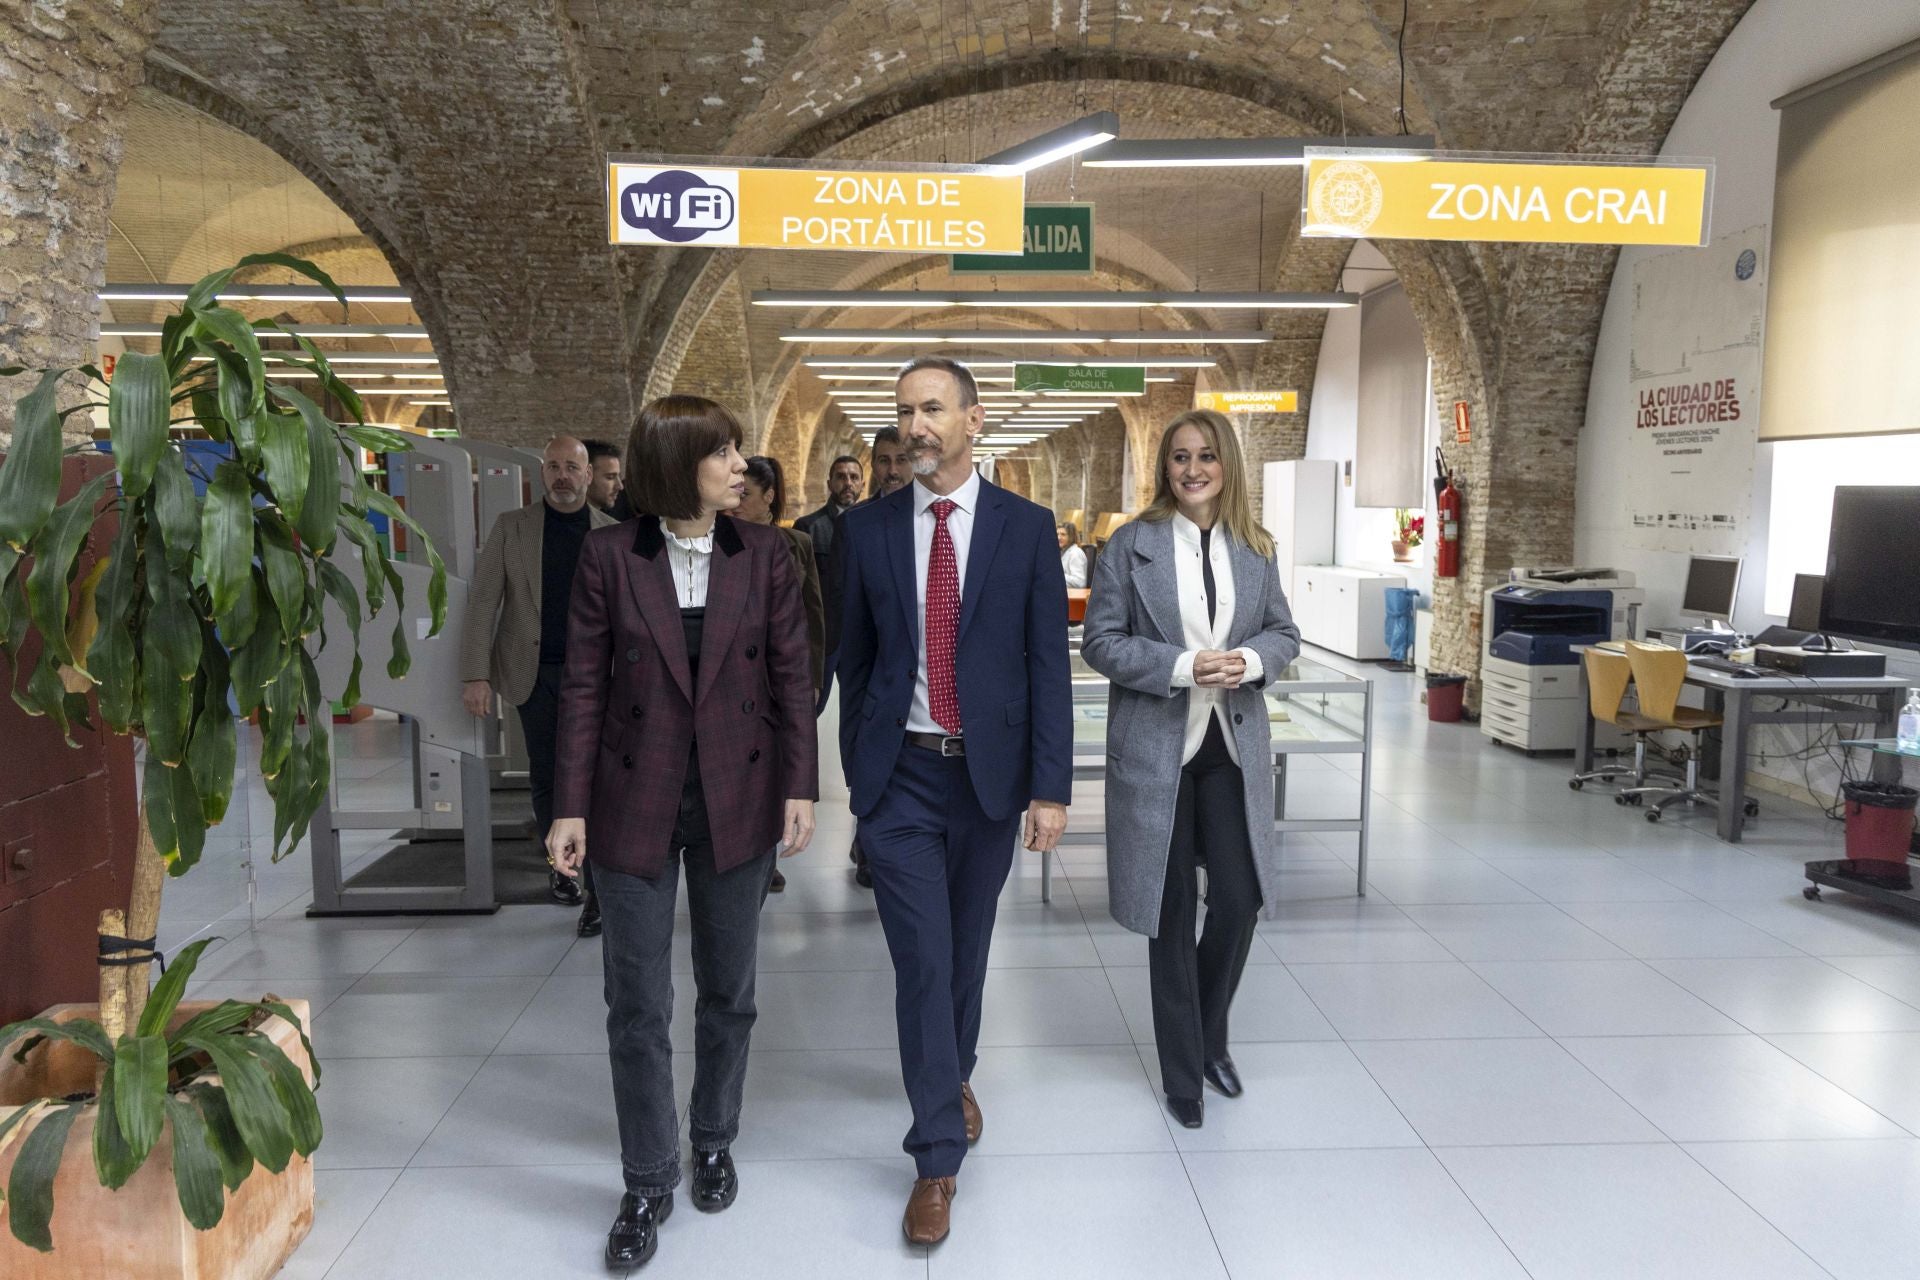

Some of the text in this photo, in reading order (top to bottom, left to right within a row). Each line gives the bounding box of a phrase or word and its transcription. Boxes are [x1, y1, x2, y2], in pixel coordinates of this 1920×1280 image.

[814, 176, 961, 206] ZONA DE
[1427, 183, 1551, 222] ZONA
[1564, 187, 1667, 225] CRAI
[782, 213, 986, 248] PORTÁTILES
[1024, 225, 1083, 253] ALIDA
[1063, 380, 1115, 390] CONSULTA
[1068, 368, 1108, 378] SALA DE
[1640, 378, 1735, 408] LA CIUDAD DE
[1637, 400, 1741, 428] LOS LECTORES
